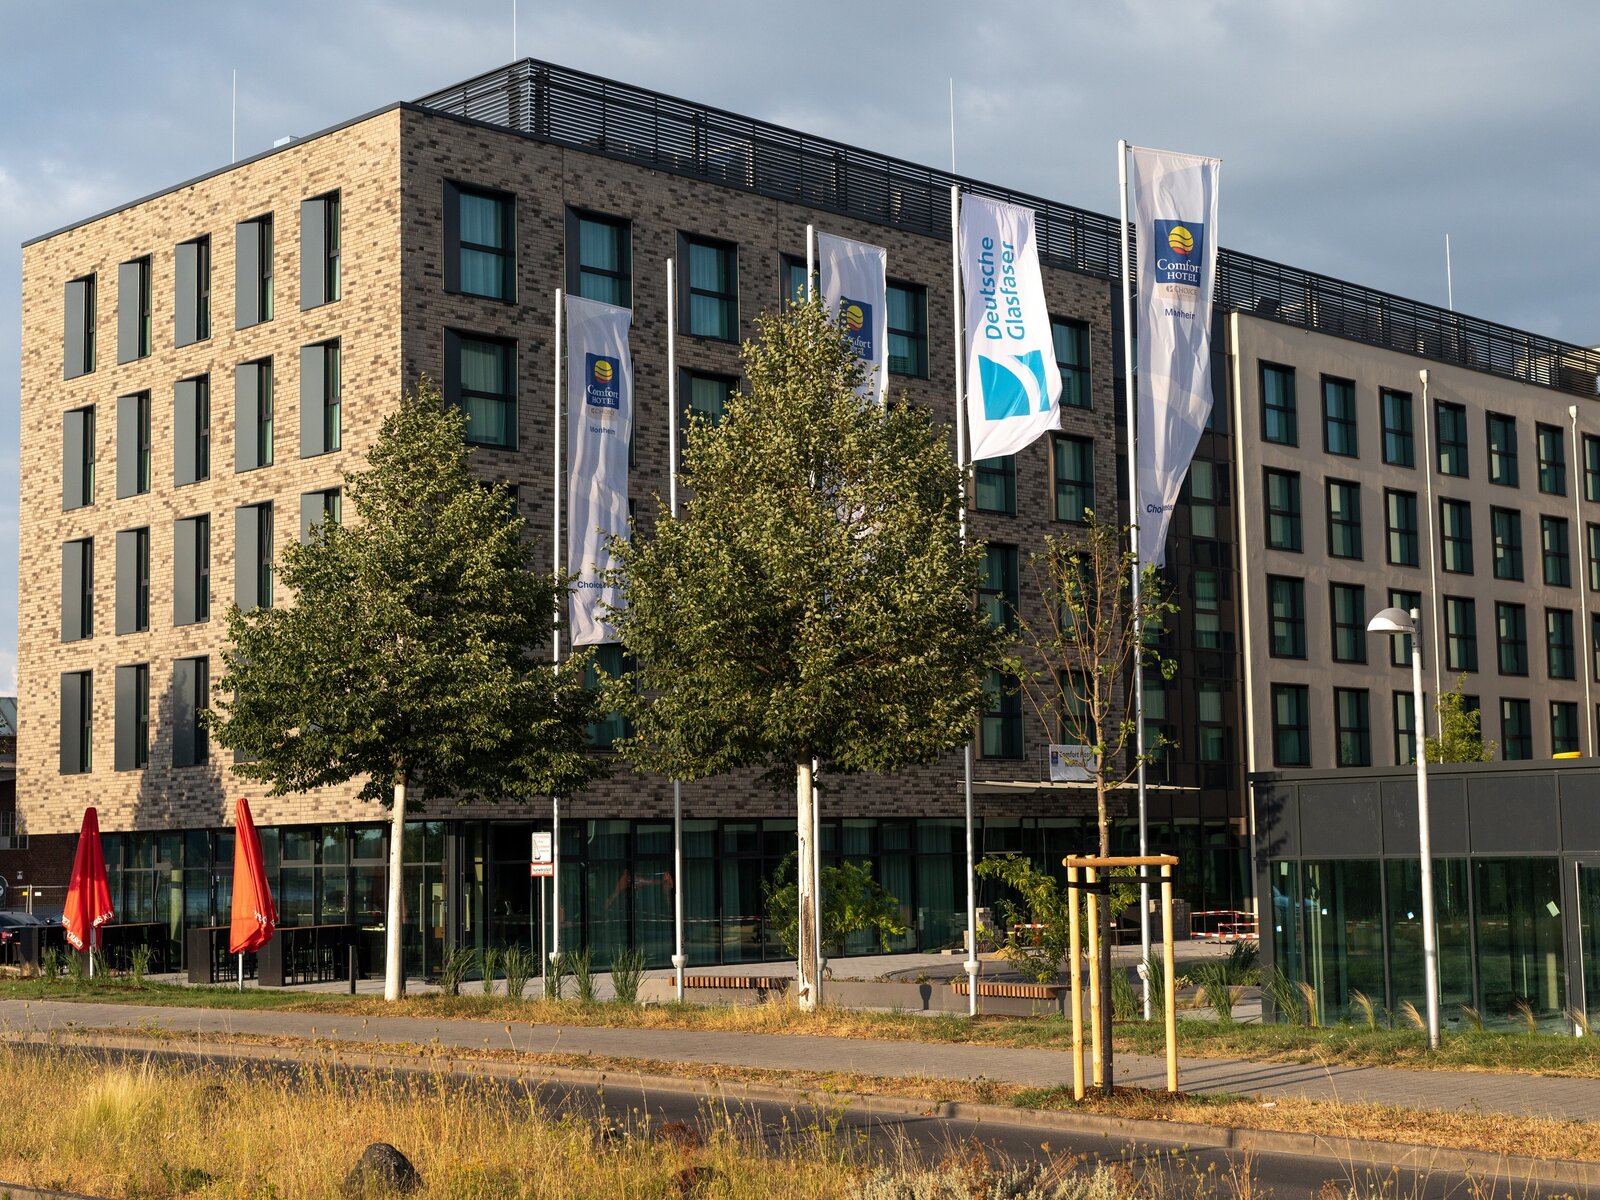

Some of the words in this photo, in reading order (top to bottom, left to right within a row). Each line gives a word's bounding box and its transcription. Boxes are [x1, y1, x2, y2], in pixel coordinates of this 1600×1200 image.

[1167, 271, 1198, 283] HOTEL
[978, 236, 1003, 340] Deutsche
[1000, 240, 1026, 340] Glasfaser
[587, 384, 619, 399] Comfort
[591, 395, 615, 406] HOTEL
